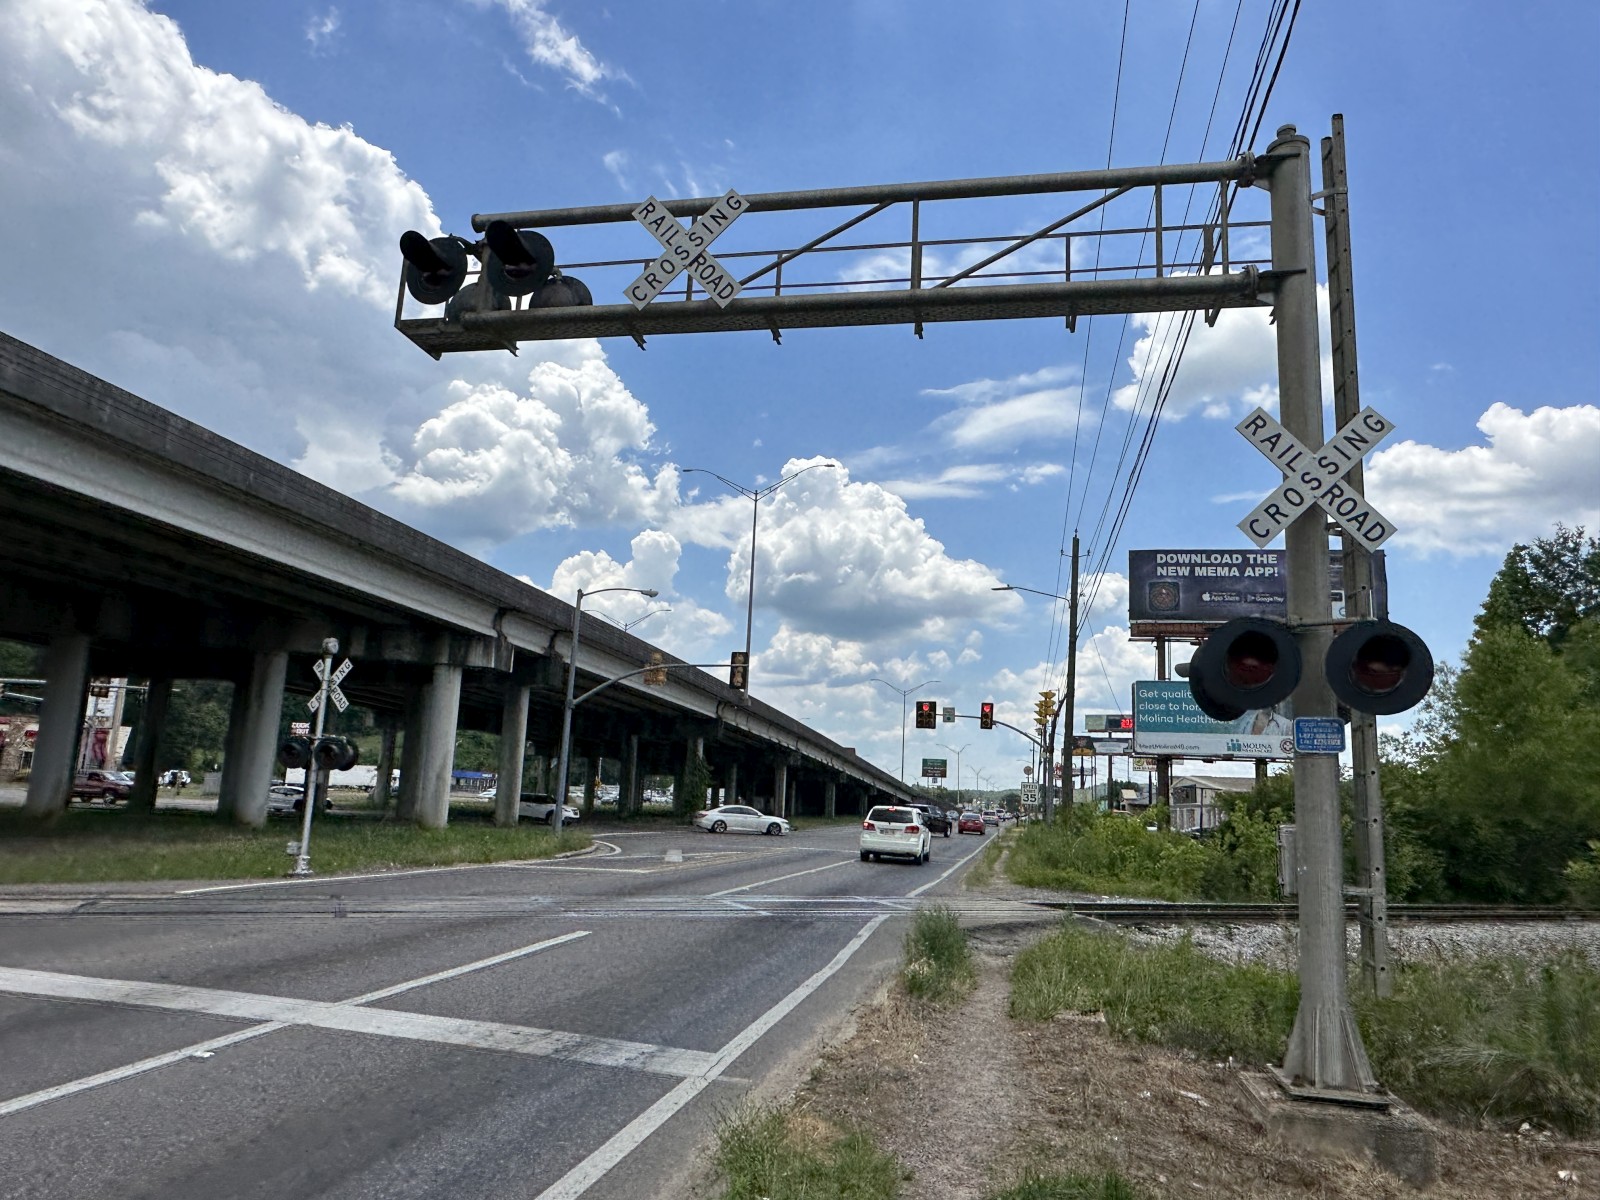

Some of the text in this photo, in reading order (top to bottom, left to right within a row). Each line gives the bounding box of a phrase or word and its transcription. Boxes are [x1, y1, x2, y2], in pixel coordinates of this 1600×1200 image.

[631, 195, 742, 302] CROSSING
[638, 201, 735, 300] RAILROAD
[1244, 414, 1386, 542] RAILROAD
[1249, 414, 1385, 539] CROSSING
[1156, 553, 1278, 564] DOWNLOAD THE
[1156, 566, 1279, 577] NEW MEMA APP!
[1139, 689, 1192, 700] Get qualit
[1139, 702, 1166, 710] close
[1168, 703, 1180, 711] to
[1139, 714, 1174, 723] Molina
[1242, 742, 1272, 750] MOLINA
[1022, 794, 1036, 802] 35
